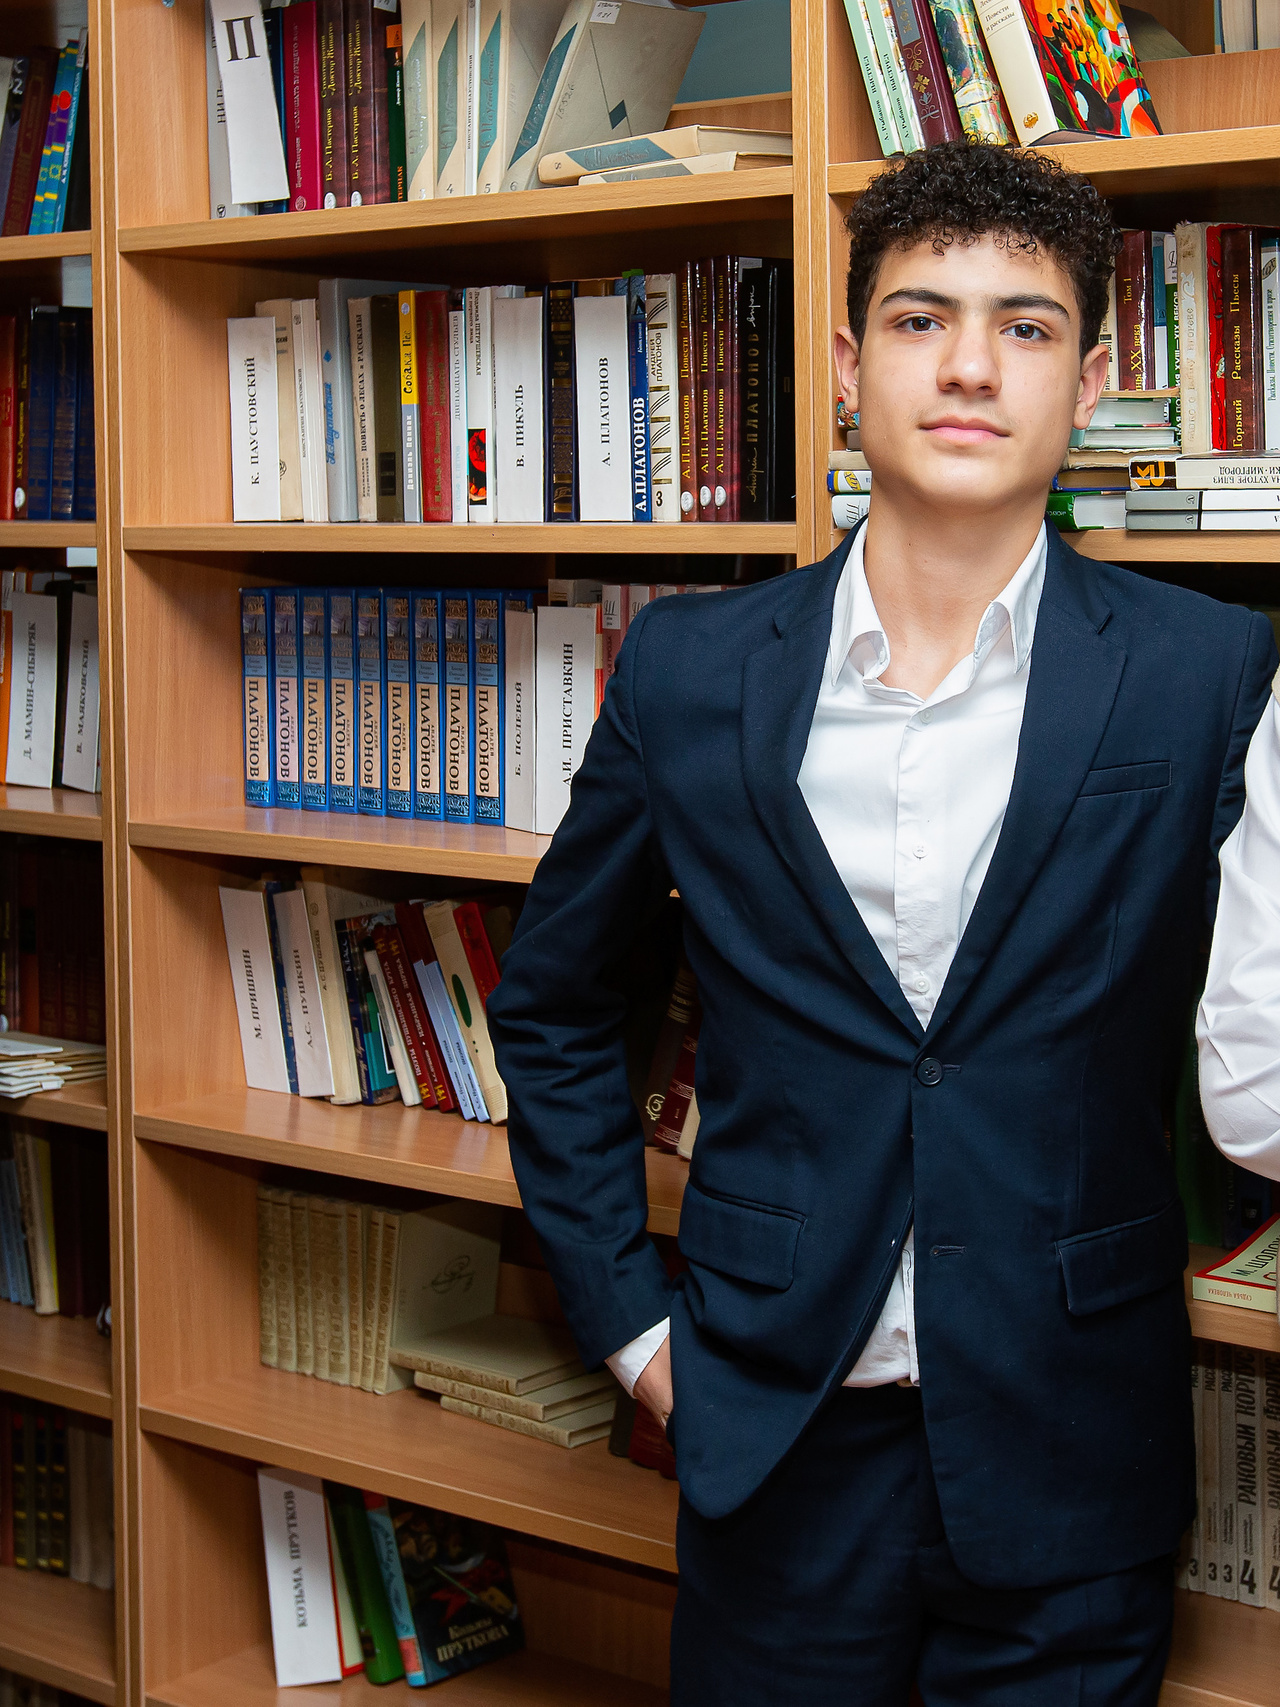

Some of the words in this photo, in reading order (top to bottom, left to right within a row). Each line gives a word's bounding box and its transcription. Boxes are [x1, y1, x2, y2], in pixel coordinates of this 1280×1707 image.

[985, 5, 1010, 23] Повести
[221, 15, 261, 62] П
[320, 35, 328, 99] Стихотворения
[862, 55, 877, 95] ВЫСТРЕЛ
[883, 53, 898, 92] ВЫСТРЕЛ
[324, 107, 333, 154] Пастернак
[351, 106, 360, 153] Пастернак
[325, 170, 333, 181] Б.
[352, 169, 359, 180] Б.
[484, 183, 491, 194] 5
[510, 181, 517, 191] 6
[680, 282, 688, 329] Рассказы
[700, 276, 708, 323] Рассказы
[716, 275, 724, 322] Рассказы
[1124, 286, 1133, 304] Том
[1230, 274, 1240, 312] Пьесы
[356, 314, 364, 363] РАССКАЗЫ
[452, 315, 460, 357] СТУЛЬЕВ
[474, 323, 482, 376] ПЕТРУШЕВСКАЯ
[716, 330, 724, 372] Повести
[1133, 325, 1141, 346] века
[1266, 310, 1276, 350] Стихотворения
[402, 351, 413, 394] Собака
[680, 337, 688, 378] Повести
[700, 331, 708, 373] Повести
[1231, 326, 1242, 380] Рассказы
[358, 373, 366, 402] ЛЕСАХ
[599, 357, 610, 444] ПЛАТОНОВ
[747, 333, 759, 443] ПЛАТОНОВ
[245, 357, 259, 466] ПАУСТОВСКИЙ
[359, 412, 367, 452] ПОВЕСТЬ
[405, 415, 413, 447] Пеннак
[515, 384, 525, 447] ПИКУЛЬ
[681, 394, 690, 446] Платонов
[701, 389, 709, 440] Платонов
[716, 388, 724, 440] Платонов
[1232, 399, 1244, 447] Горький
[251, 470, 260, 486] К.
[405, 451, 414, 490] Даниэль
[516, 454, 525, 468] В.
[601, 452, 611, 467] А.
[682, 463, 691, 479] А.
[700, 459, 709, 474] А.
[716, 459, 724, 474] А.
[1213, 476, 1235, 484] БЛИЗ
[1219, 465, 1264, 475] МИРГОРОД
[1237, 475, 1269, 484] ХУТОРЕ
[655, 490, 663, 507] 3
[24, 621, 37, 743] МАМИН-СИБИРЯК
[77, 639, 90, 737] МАЯКОВСКИЙ
[562, 642, 574, 750] ПРИСТАВКИН
[248, 679, 260, 778] ПЛАТОНОВ
[279, 680, 291, 779] ПЛАТОНОВ
[307, 682, 319, 781] ПЛАТОНОВ
[335, 683, 346, 782] ПЛАТОНОВ
[363, 683, 374, 785] ПЛАТОНОВ
[391, 685, 402, 787] ПЛАТОНОВ
[420, 687, 430, 790] ПЛАТОНОВ
[449, 688, 460, 791] ПЛАТОНОВ
[513, 682, 523, 756] ПОЛЕВОЙ
[22, 747, 32, 760] Д.
[76, 741, 83, 753] В.
[479, 689, 489, 794] ПЛАТОНОВ
[514, 762, 522, 778] Б.
[242, 949, 261, 1017] ПРИШВИН
[293, 949, 309, 1014] ПУШКИН
[254, 1022, 263, 1040] М.
[391, 987, 413, 1047] ПУШКИНСКОГО
[406, 992, 425, 1038] ИЗБРАННАЯ
[409, 1048, 422, 1076] ПОЭТЫ
[1207, 1287, 1233, 1298] ЧЕЛОВЕКА
[1233, 1293, 1252, 1301] СУДЬБА
[1235, 1351, 1256, 1417] КОРПУС
[1236, 1424, 1257, 1506] РАКОВЫЙ
[284, 1490, 301, 1560] ПРУТКОВ
[1189, 1558, 1199, 1577] 3
[1207, 1562, 1218, 1581] 3
[1223, 1564, 1233, 1583] 3
[1240, 1560, 1258, 1595] 4
[293, 1567, 309, 1628] КОЗЬМА
